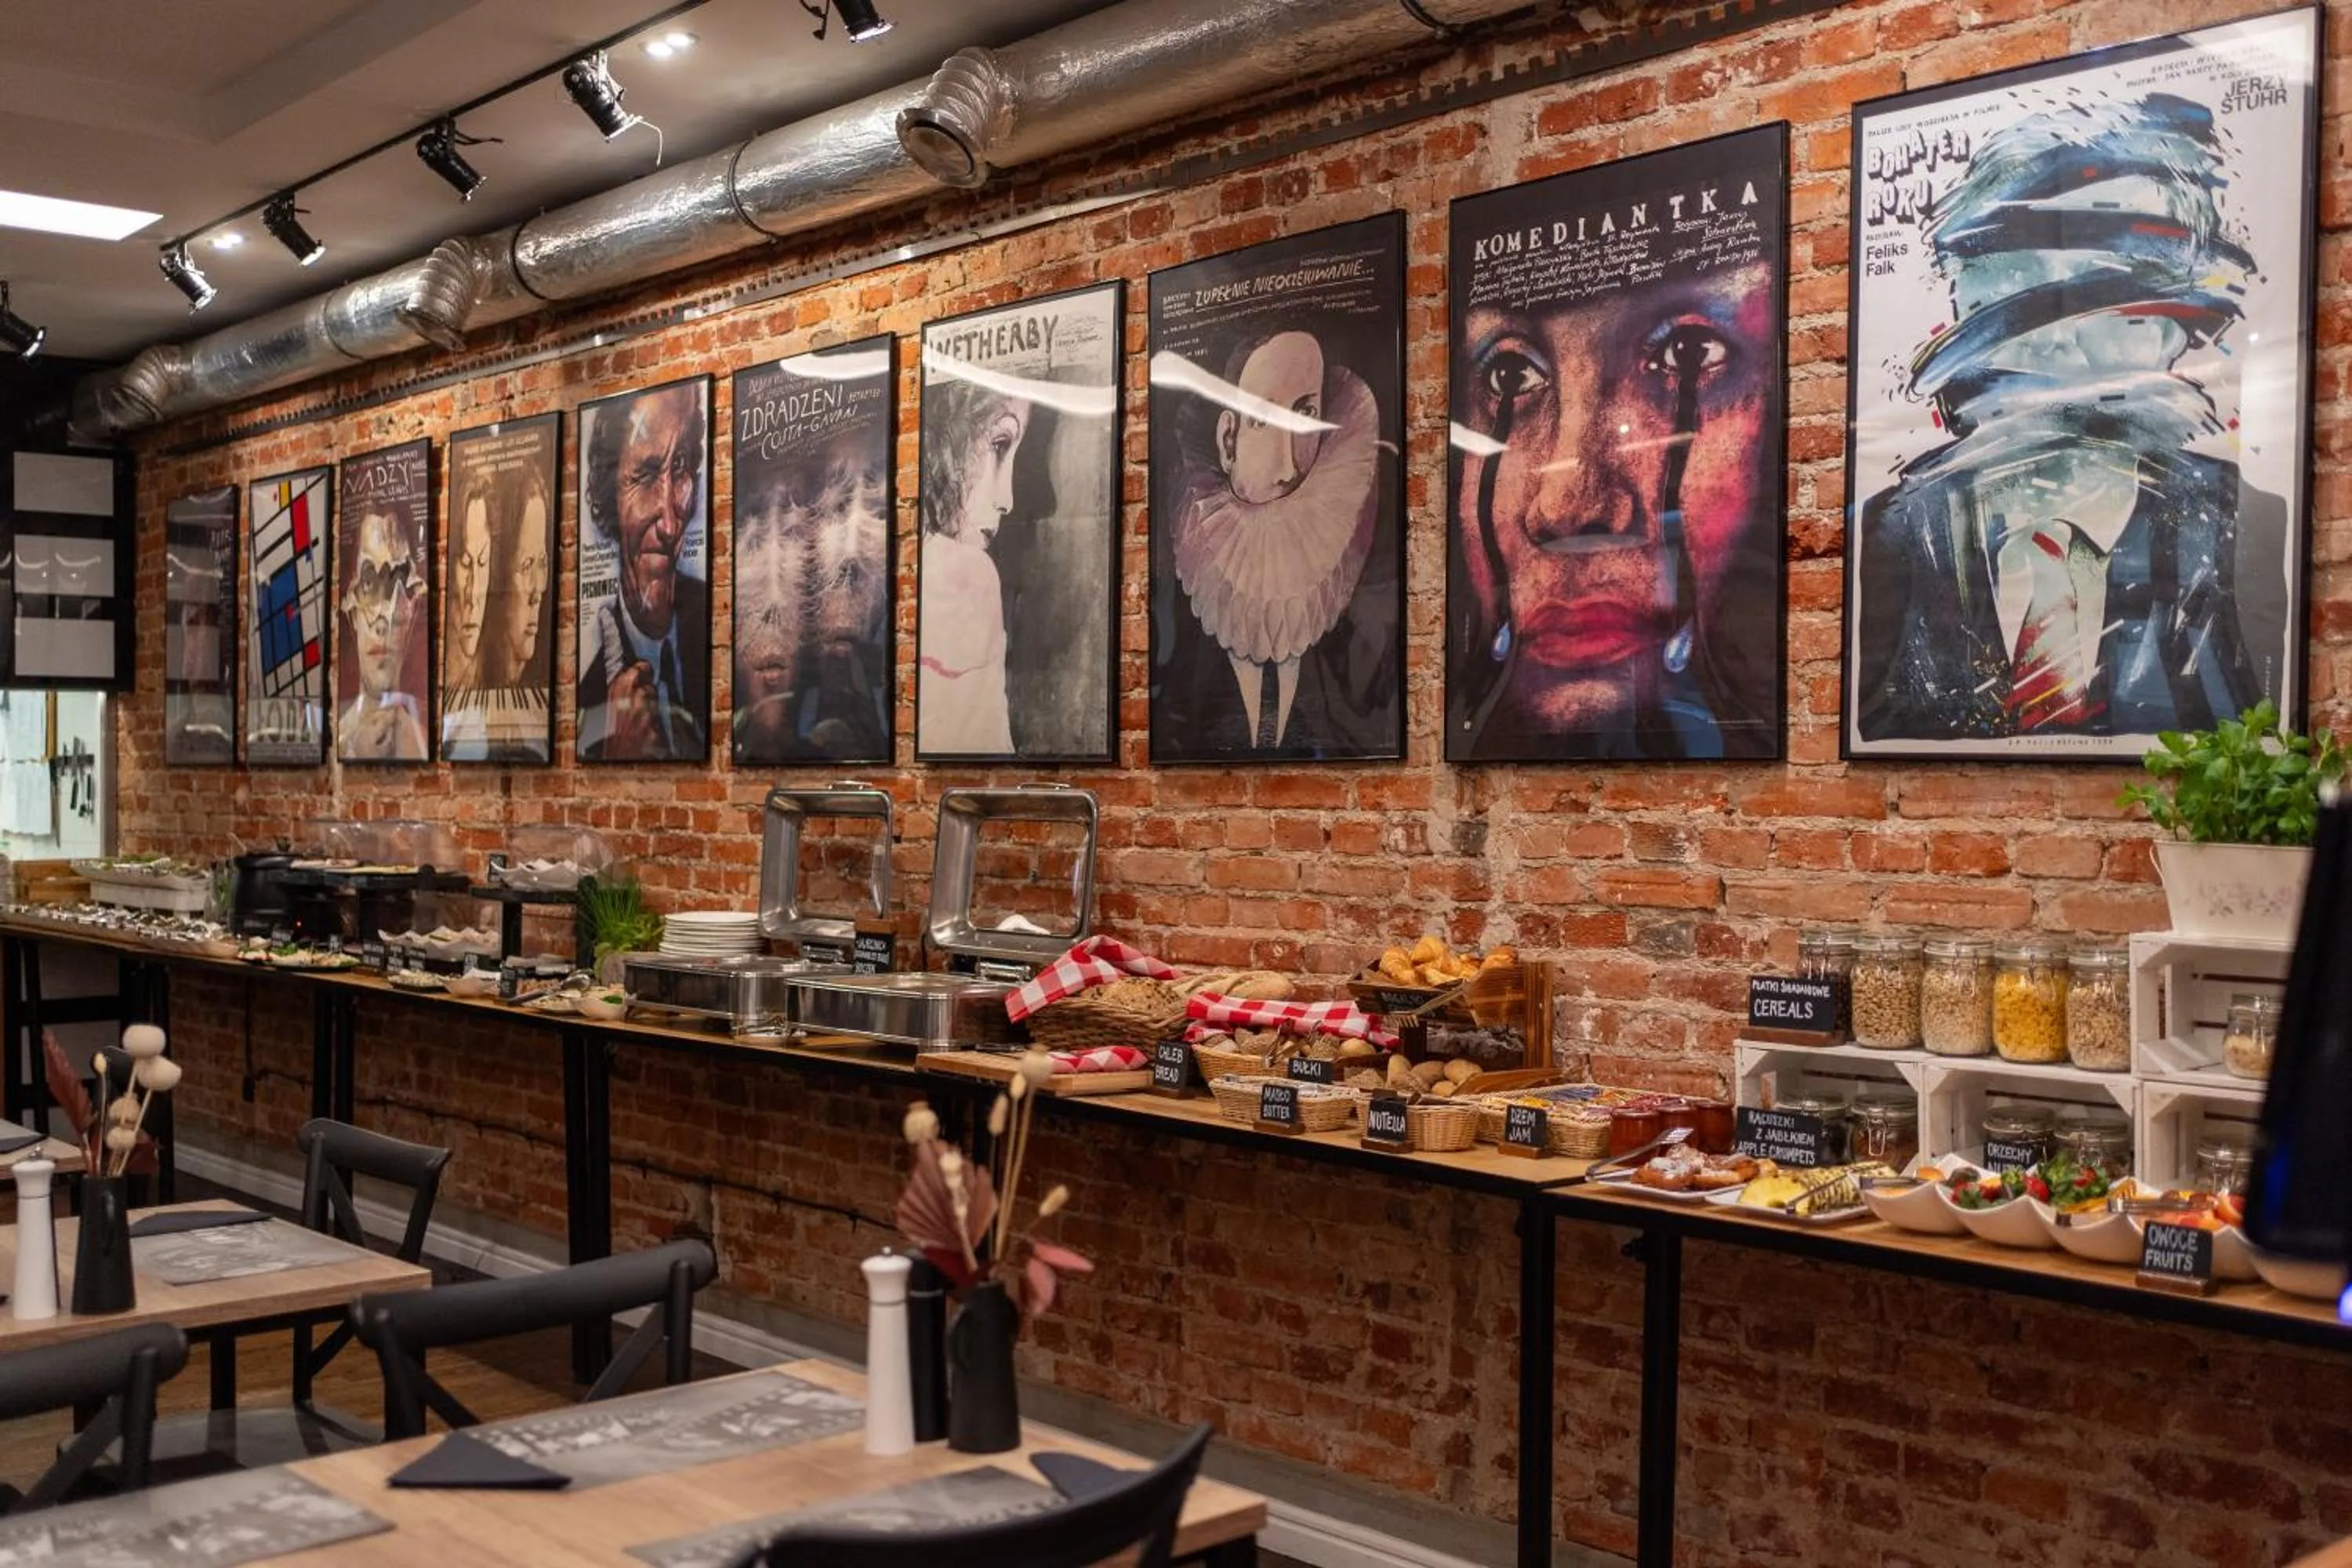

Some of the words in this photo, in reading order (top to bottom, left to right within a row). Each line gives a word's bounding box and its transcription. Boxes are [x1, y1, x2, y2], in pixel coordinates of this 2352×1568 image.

[2221, 89, 2287, 114] STUHR
[1868, 129, 1970, 182] BOHATER
[1867, 177, 1933, 226] ROKU
[1474, 181, 1759, 261] KOMEDIANTKA
[1866, 242, 1908, 260] Feliks
[1866, 260, 1896, 277] Falk
[1196, 280, 1251, 307] ZUPEŁNIE
[741, 383, 844, 441] ZDRADZENI
[1754, 998, 1813, 1018] CEREALS
[1158, 1045, 1183, 1063] CHLEB
[1155, 1065, 1179, 1083] BREAD
[1293, 1060, 1321, 1076] BUŁKI
[1263, 1105, 1290, 1120] BUTTER
[1369, 1110, 1406, 1134] NUTELLA
[1508, 1127, 1531, 1142] JAM
[1755, 1127, 1762, 1140] Z
[1737, 1141, 1767, 1156] APPLE
[1987, 1142, 2032, 1164] ORZECHY
[2149, 1225, 2198, 1252] OWOCE
[2145, 1249, 2194, 1272] FRUITS
